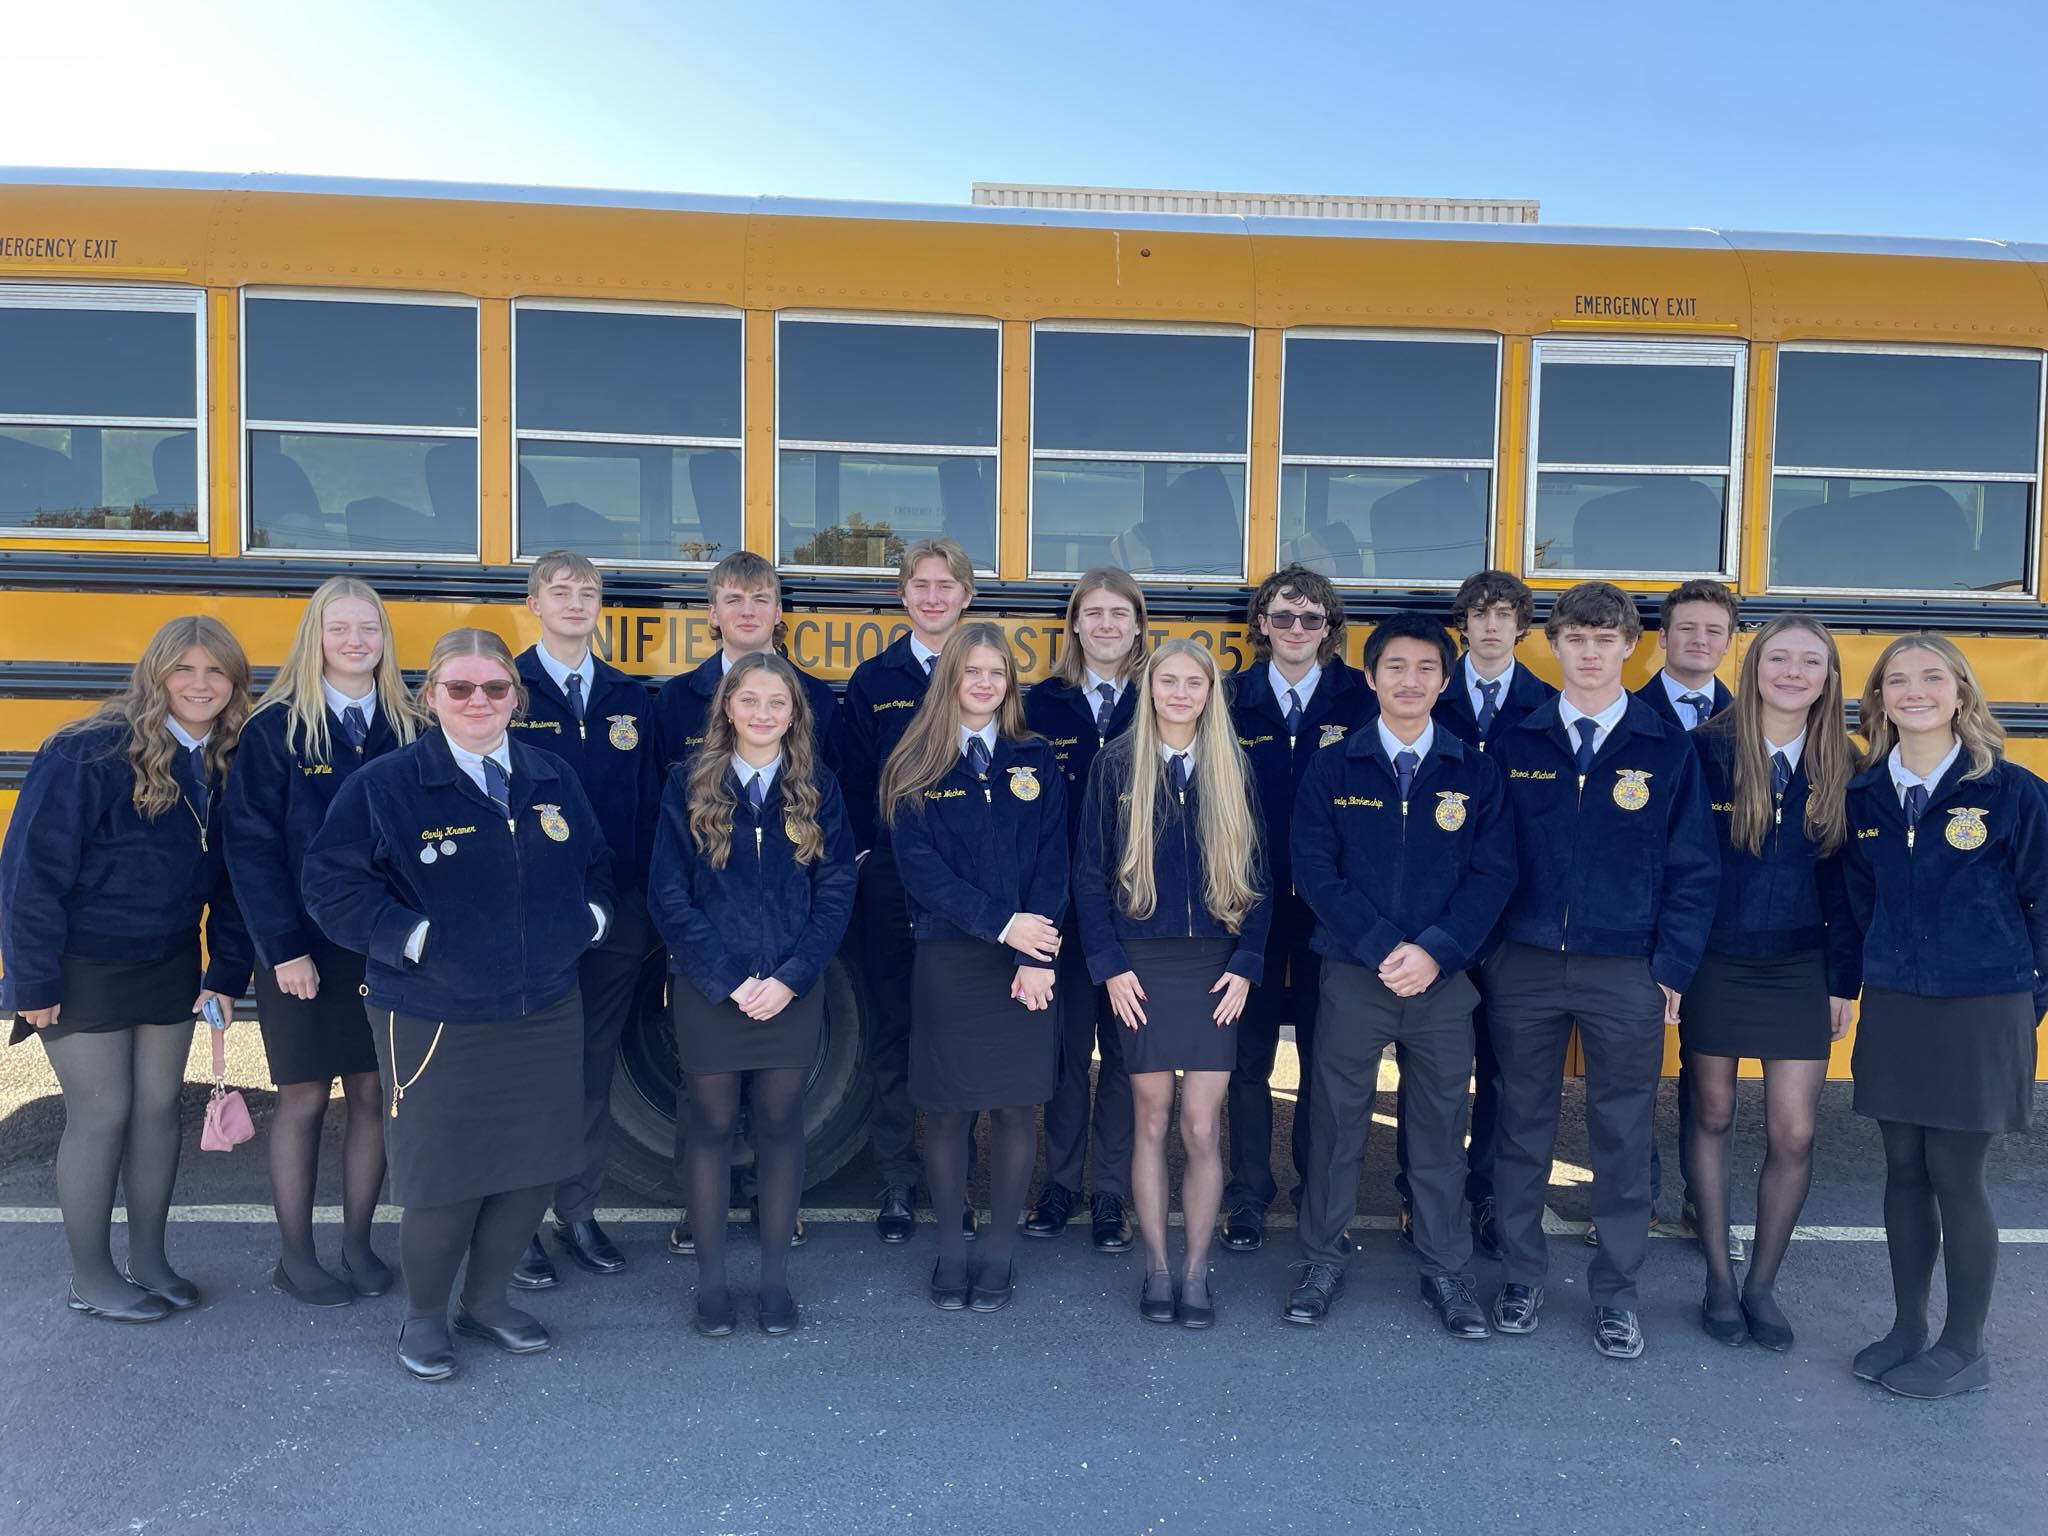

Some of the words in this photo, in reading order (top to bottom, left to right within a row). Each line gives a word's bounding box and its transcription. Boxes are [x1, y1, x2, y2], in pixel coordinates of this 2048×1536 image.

[0, 237, 77, 258] ERGENCY
[84, 239, 118, 259] EXIT
[1575, 295, 1660, 316] EMERGENCY
[1667, 297, 1697, 317] EXIT
[421, 828, 443, 841] Carly
